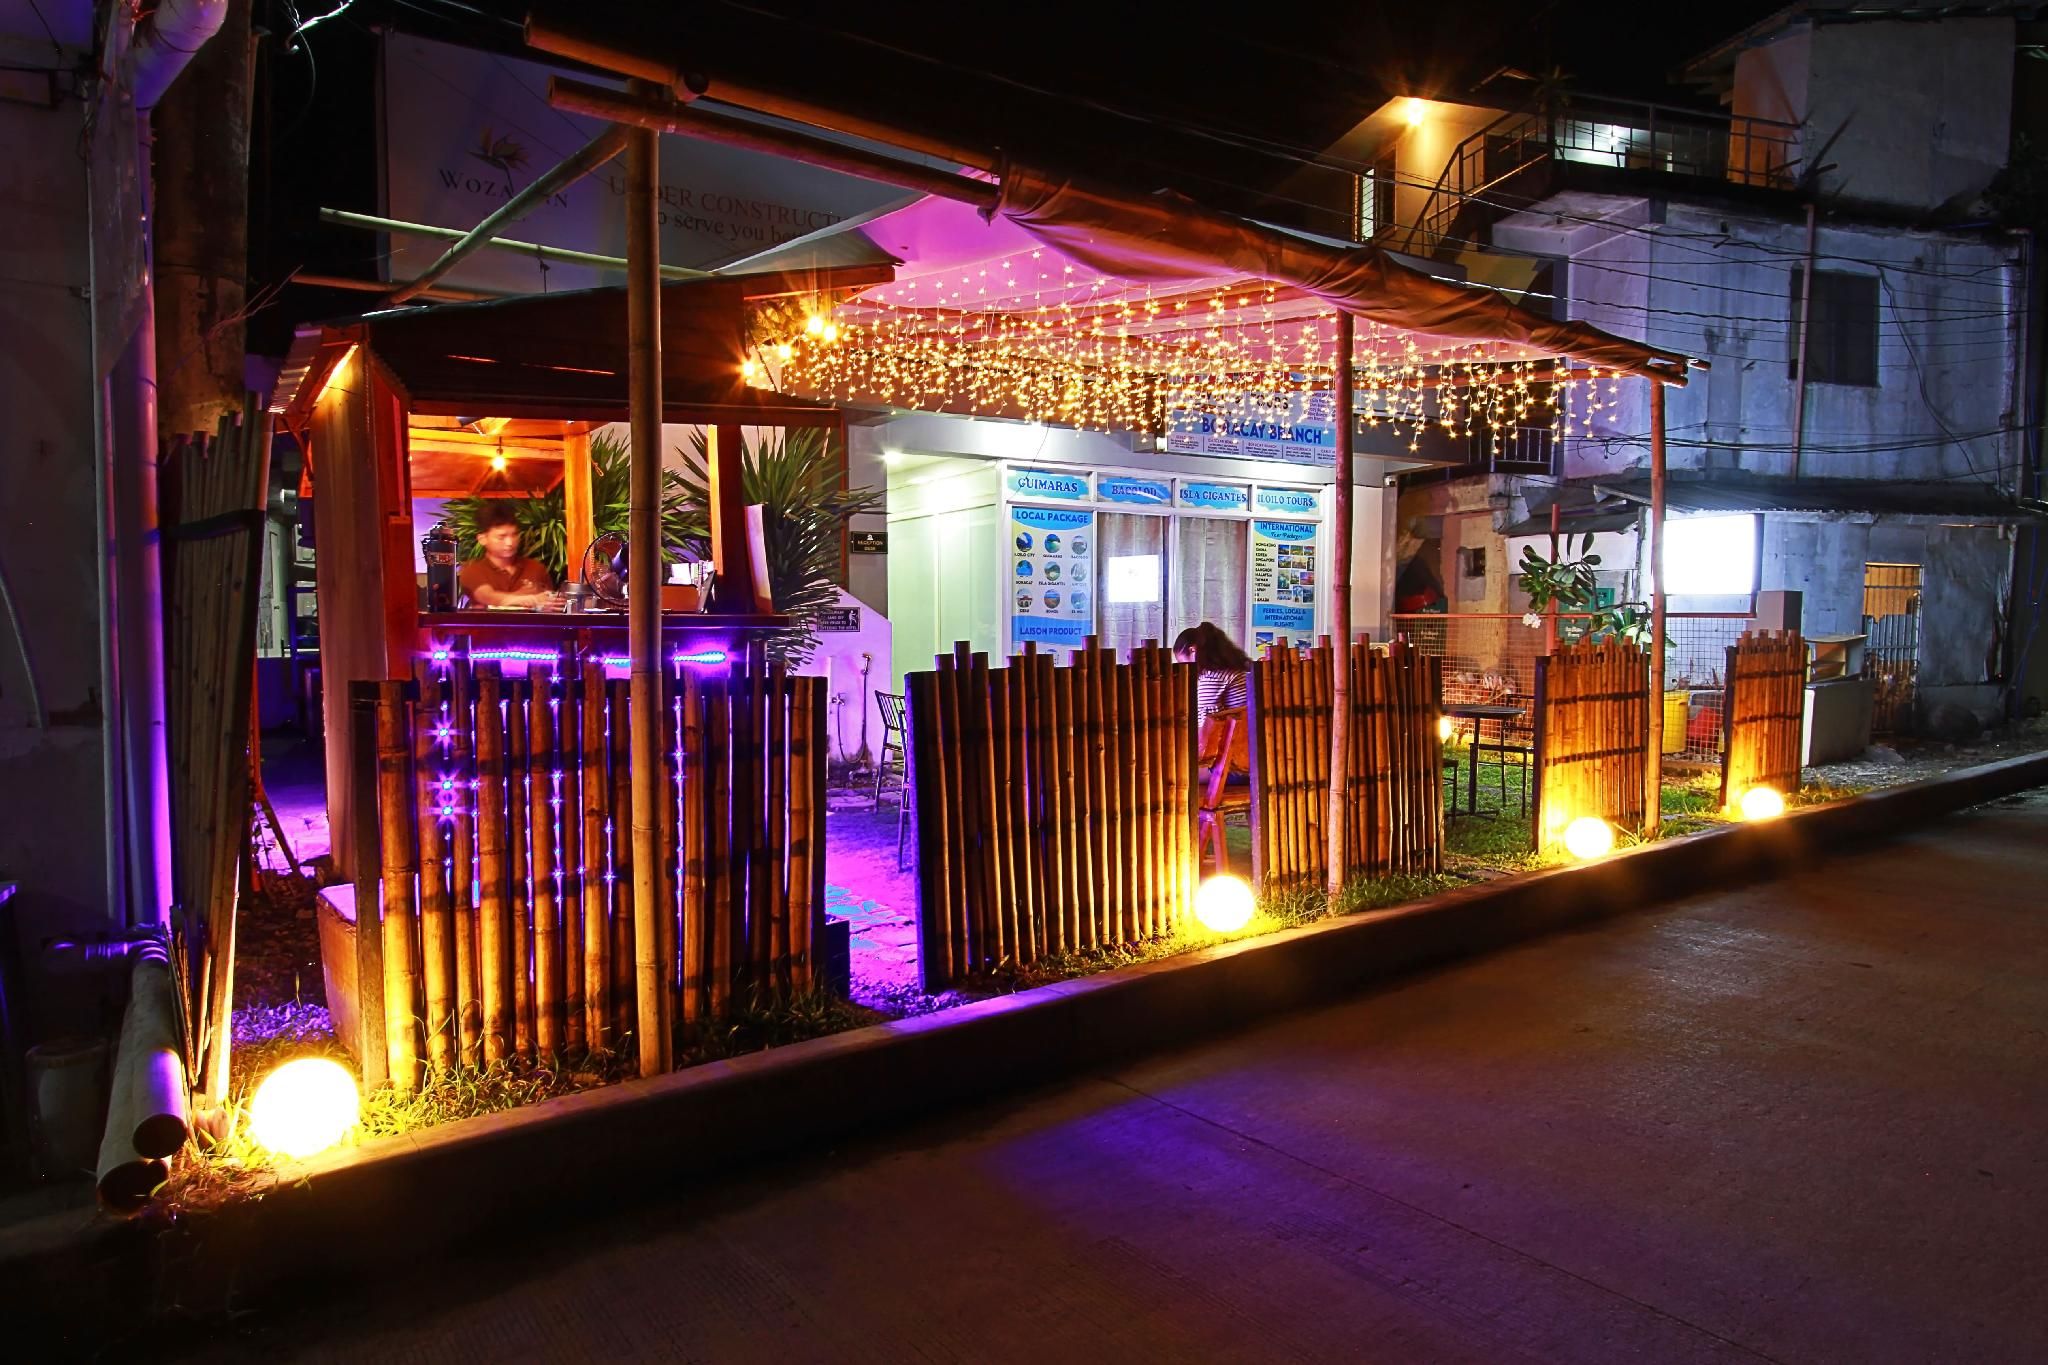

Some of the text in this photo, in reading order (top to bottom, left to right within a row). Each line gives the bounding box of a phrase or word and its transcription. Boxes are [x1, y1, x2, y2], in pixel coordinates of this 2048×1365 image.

[439, 168, 514, 199] WOZA
[609, 176, 695, 207] UER
[674, 214, 724, 234] serve
[730, 223, 764, 241] you
[1269, 425, 1321, 444] BRANCH
[1018, 478, 1078, 492] GUIMARAS
[1112, 485, 1157, 497] BACOLOD
[1180, 489, 1247, 502] ISLA GIGANTES
[1257, 494, 1313, 507] ILOILO TOURS
[1016, 511, 1088, 523] LOCAL PACKAGE
[1260, 523, 1312, 533] INTERNATIONAL
[1020, 627, 1082, 635] LAISON PRODUCT
